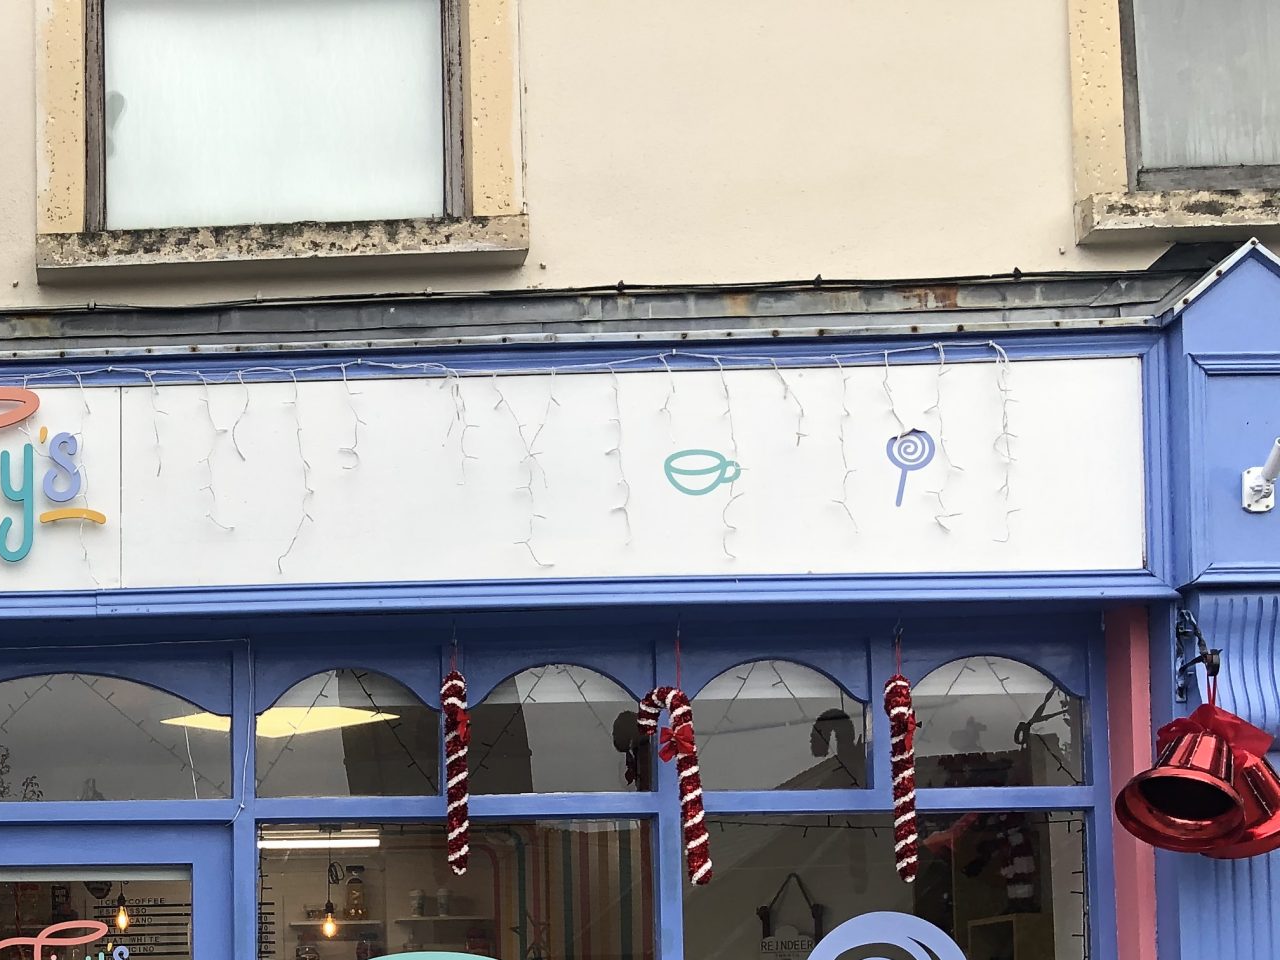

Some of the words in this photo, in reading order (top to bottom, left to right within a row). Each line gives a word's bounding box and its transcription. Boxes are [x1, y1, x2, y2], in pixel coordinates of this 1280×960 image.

[128, 897, 166, 905] COFFEE
[99, 907, 147, 916] ESPSSO
[760, 939, 814, 951] REINDEER
